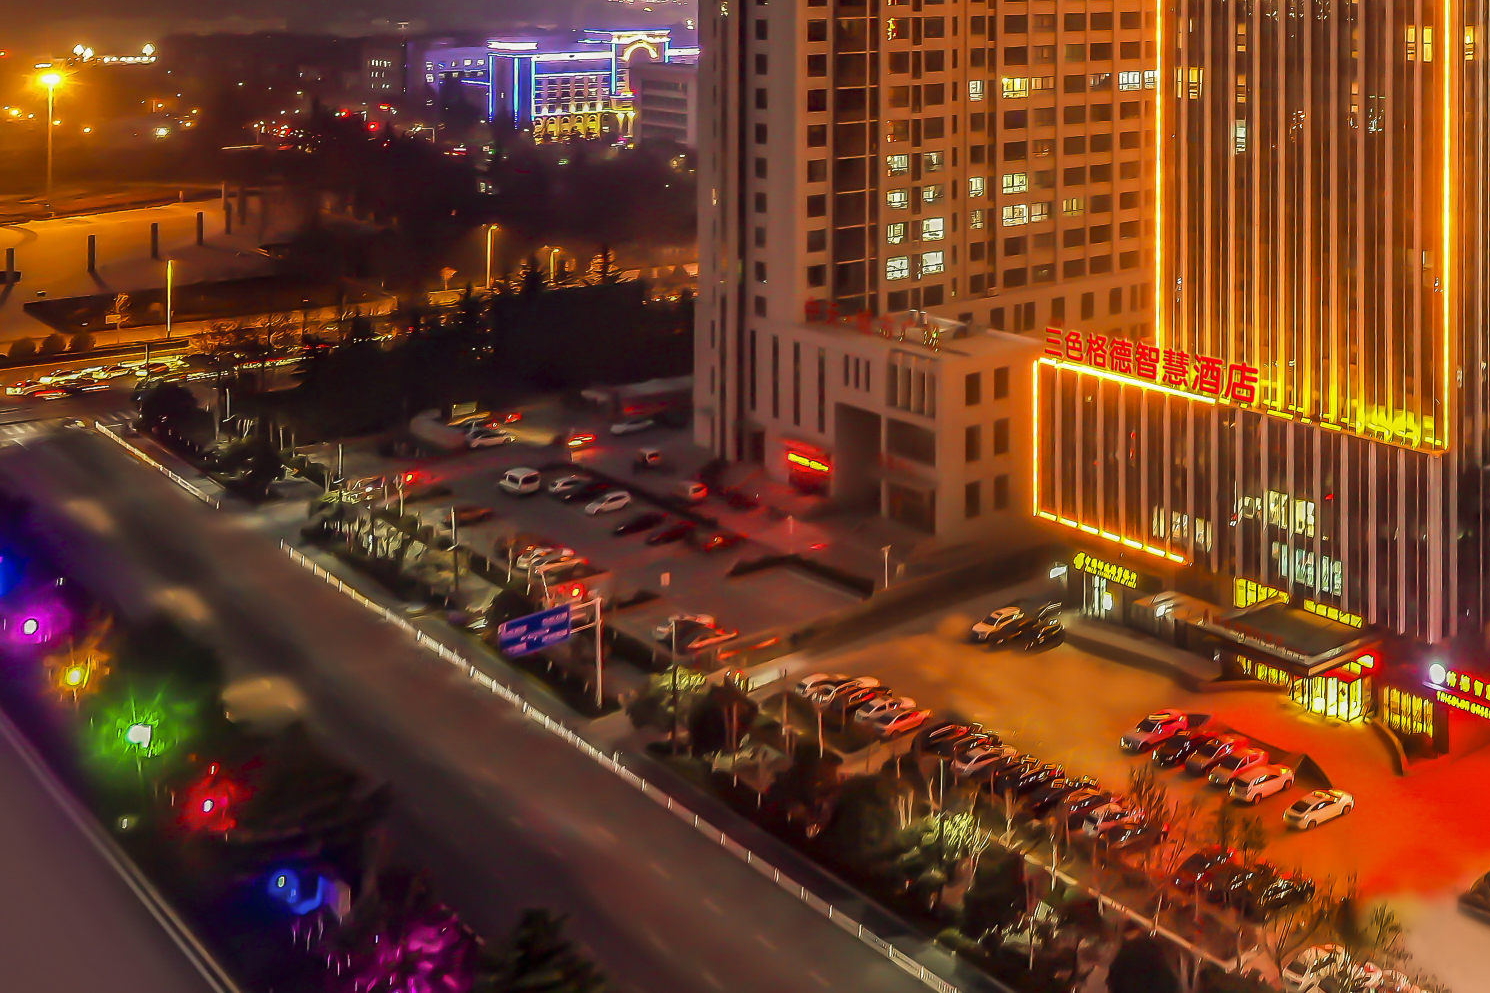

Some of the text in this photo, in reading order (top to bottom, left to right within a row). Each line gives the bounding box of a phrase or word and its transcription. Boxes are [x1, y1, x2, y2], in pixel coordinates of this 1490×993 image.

[1044, 327, 1259, 403] 三色格德智慧酒店
